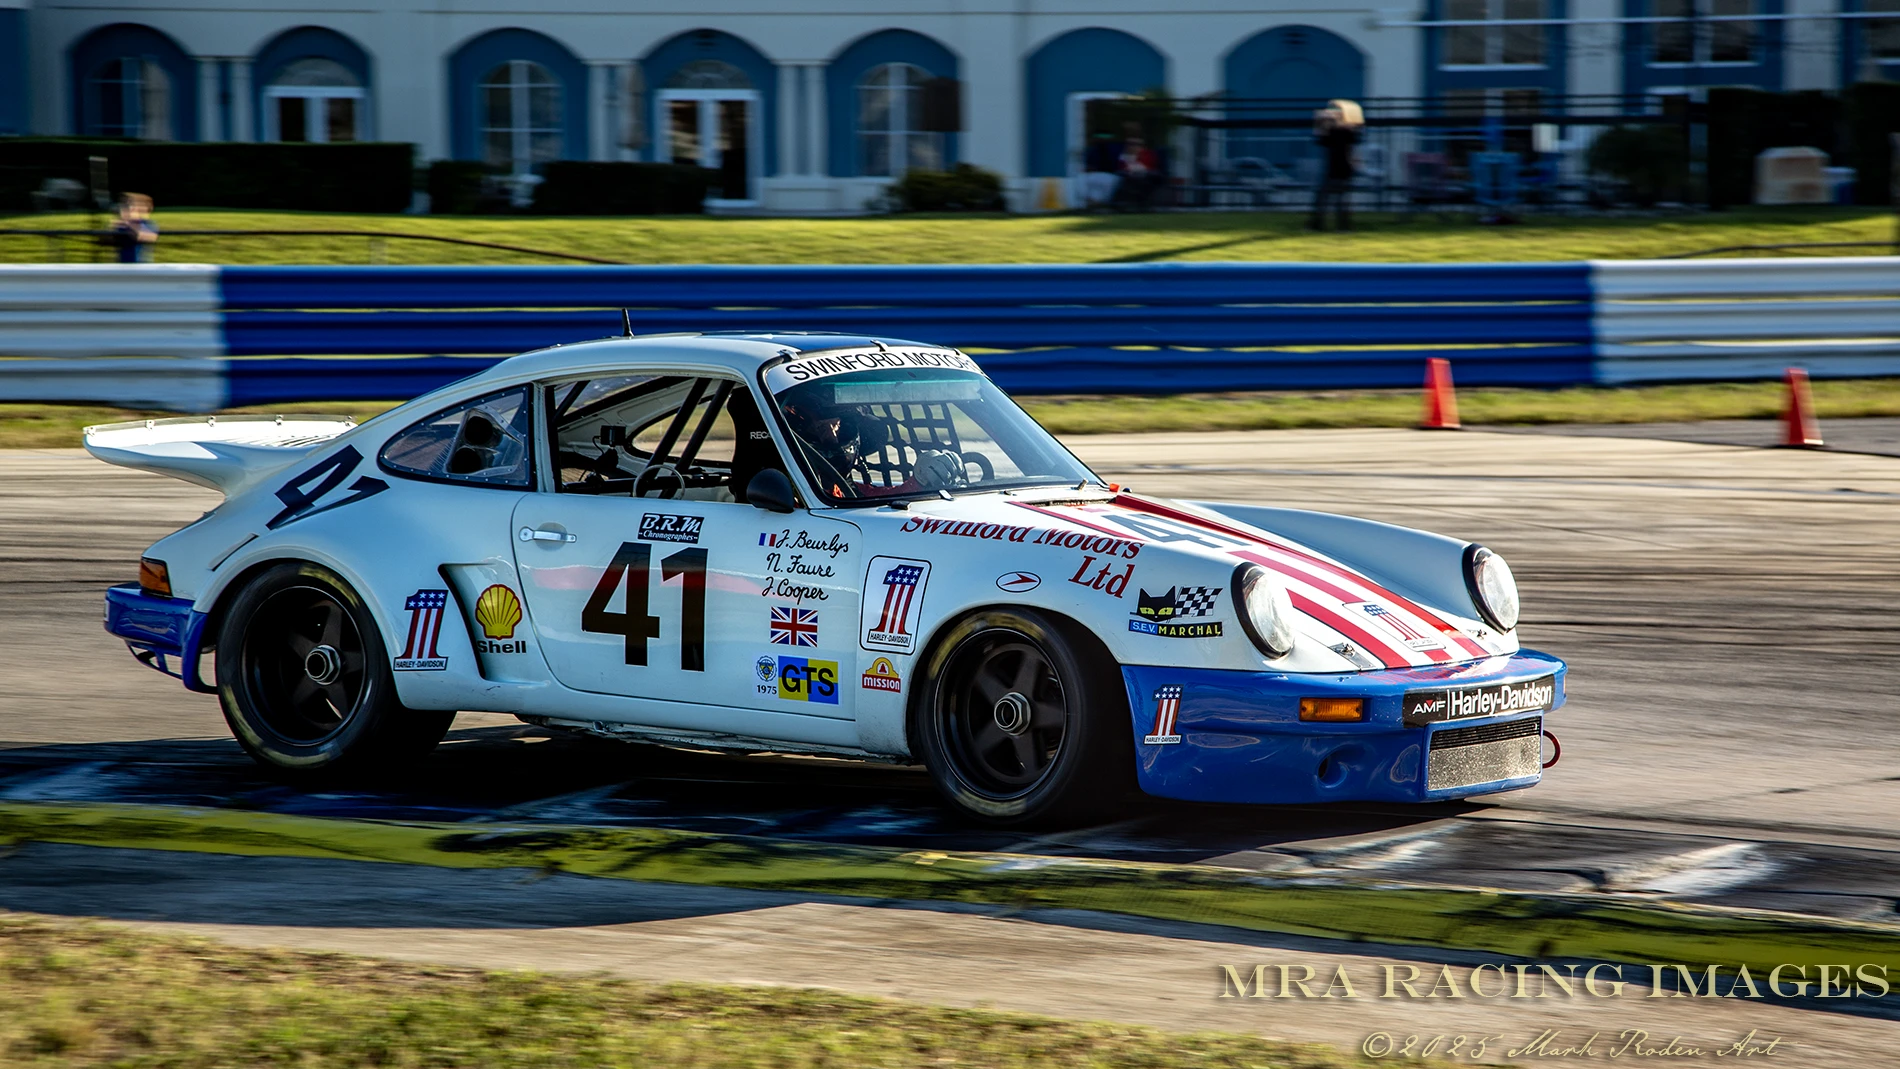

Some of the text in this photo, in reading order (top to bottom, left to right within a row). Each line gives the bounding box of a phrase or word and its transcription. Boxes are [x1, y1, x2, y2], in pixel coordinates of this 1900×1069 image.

[785, 352, 904, 381] SWINFORD
[642, 514, 701, 533] B.R.M
[1100, 513, 1253, 548] 41
[789, 530, 849, 558] Beurlys
[900, 516, 1145, 559] Swinford Motors
[766, 553, 835, 577] N. Faure
[1068, 555, 1136, 599] Ltd
[777, 579, 829, 605] Cooper
[581, 541, 709, 672] 41
[870, 632, 910, 645] HARLEY-DAVIDSON
[1132, 621, 1222, 636] S.E.V. MARCHAL
[477, 640, 526, 654] Shell
[396, 659, 445, 668] HARLEY-DAVIDSON
[757, 684, 777, 695] 1975
[781, 664, 835, 696] GTS
[1412, 680, 1552, 716] AMF Harley-Davidson
